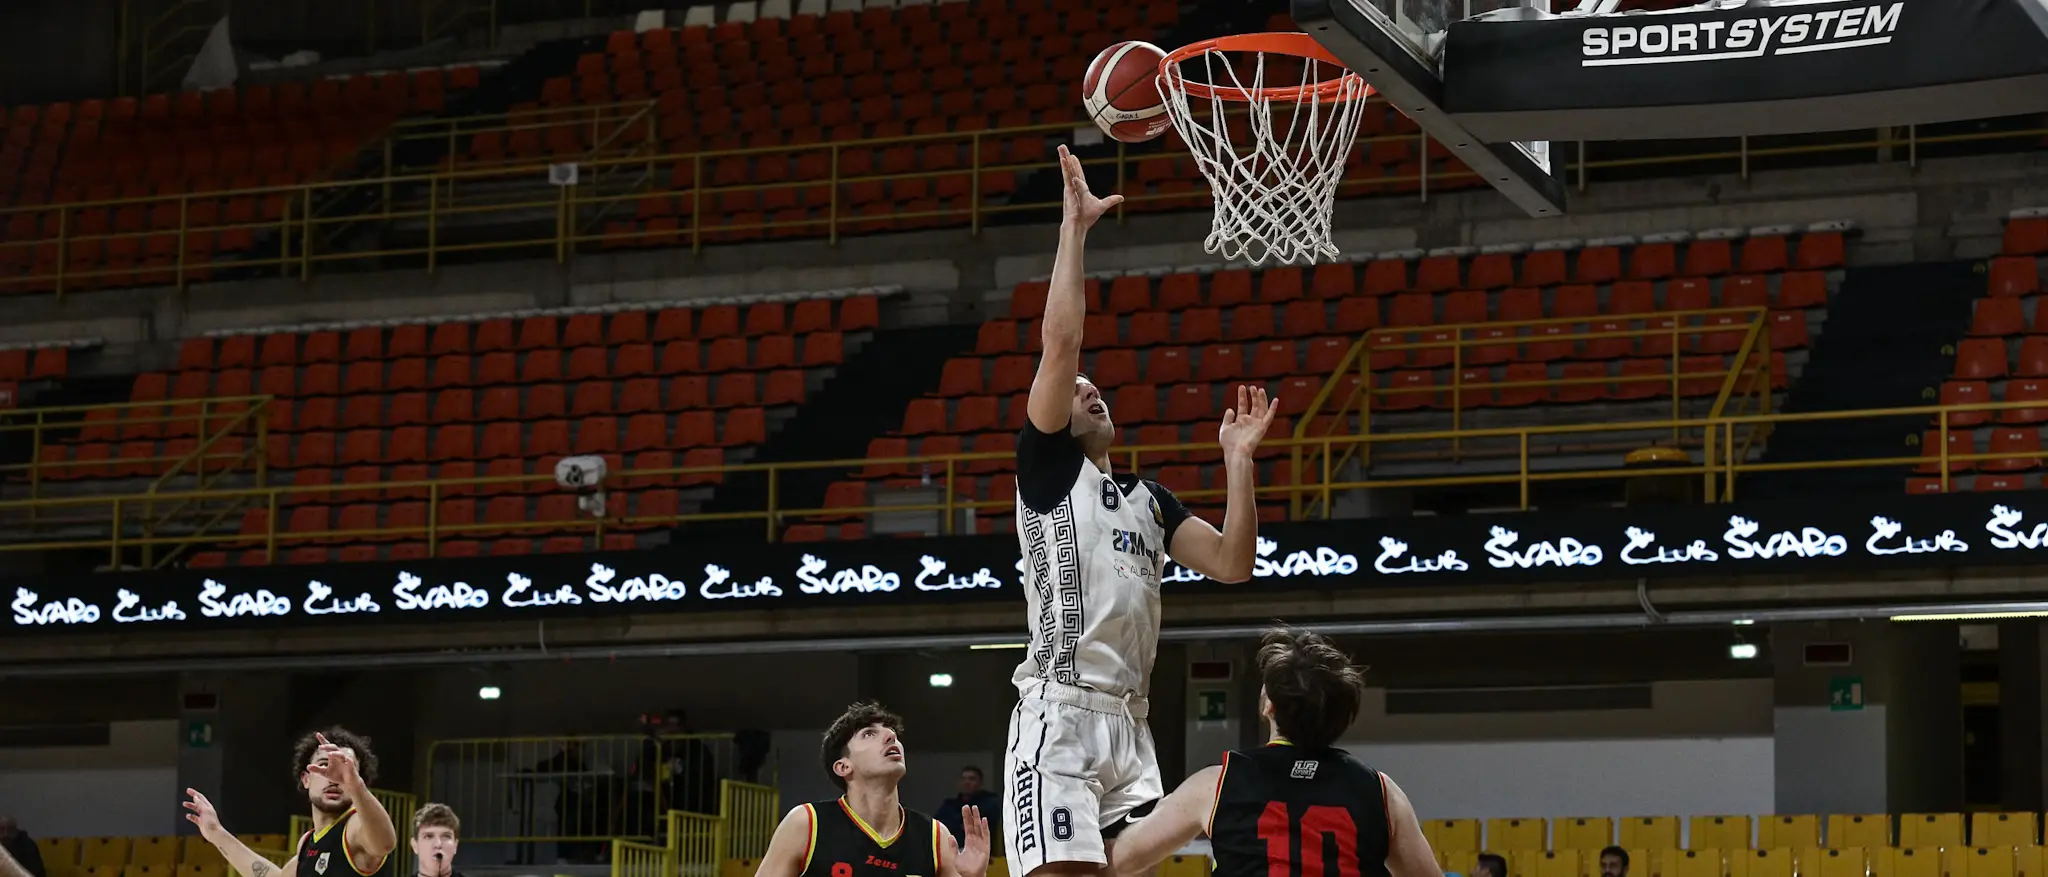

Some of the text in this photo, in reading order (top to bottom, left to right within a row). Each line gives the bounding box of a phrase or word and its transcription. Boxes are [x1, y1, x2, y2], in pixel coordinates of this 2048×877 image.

[1582, 3, 1903, 58] SPORTSYSTEM
[1100, 476, 1121, 512] 8
[1051, 806, 1075, 842] 8
[1257, 800, 1361, 877] 10
[865, 855, 898, 870] Zeus
